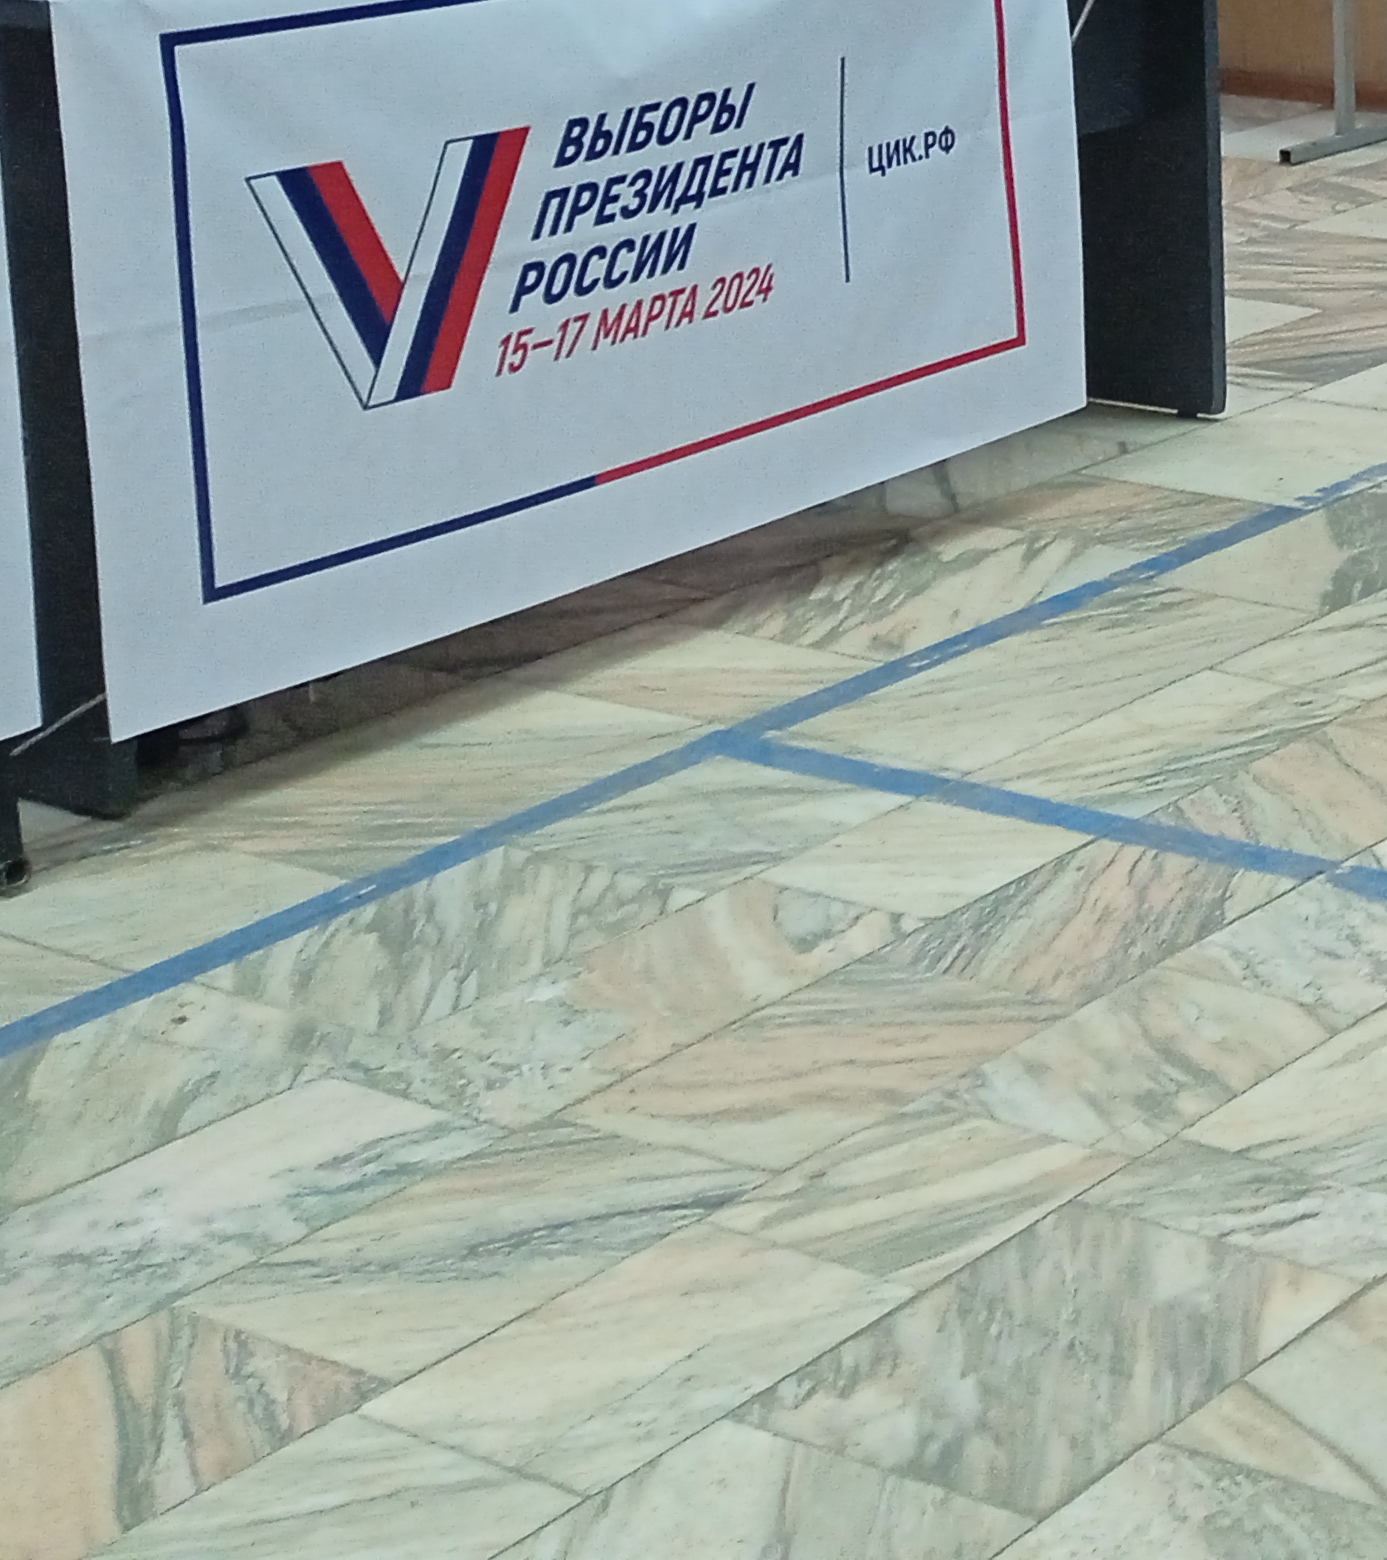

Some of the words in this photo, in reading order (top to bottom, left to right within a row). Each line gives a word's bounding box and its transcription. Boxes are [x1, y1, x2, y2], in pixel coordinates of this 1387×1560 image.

[552, 81, 756, 169] ВЫБОРЫ
[866, 124, 957, 177] ЦИК.РФ
[530, 132, 805, 241] ПРЕЗИДЕНТА
[508, 221, 698, 315] РОССИИ
[590, 283, 700, 351] МАРТА
[701, 262, 775, 322] 2024
